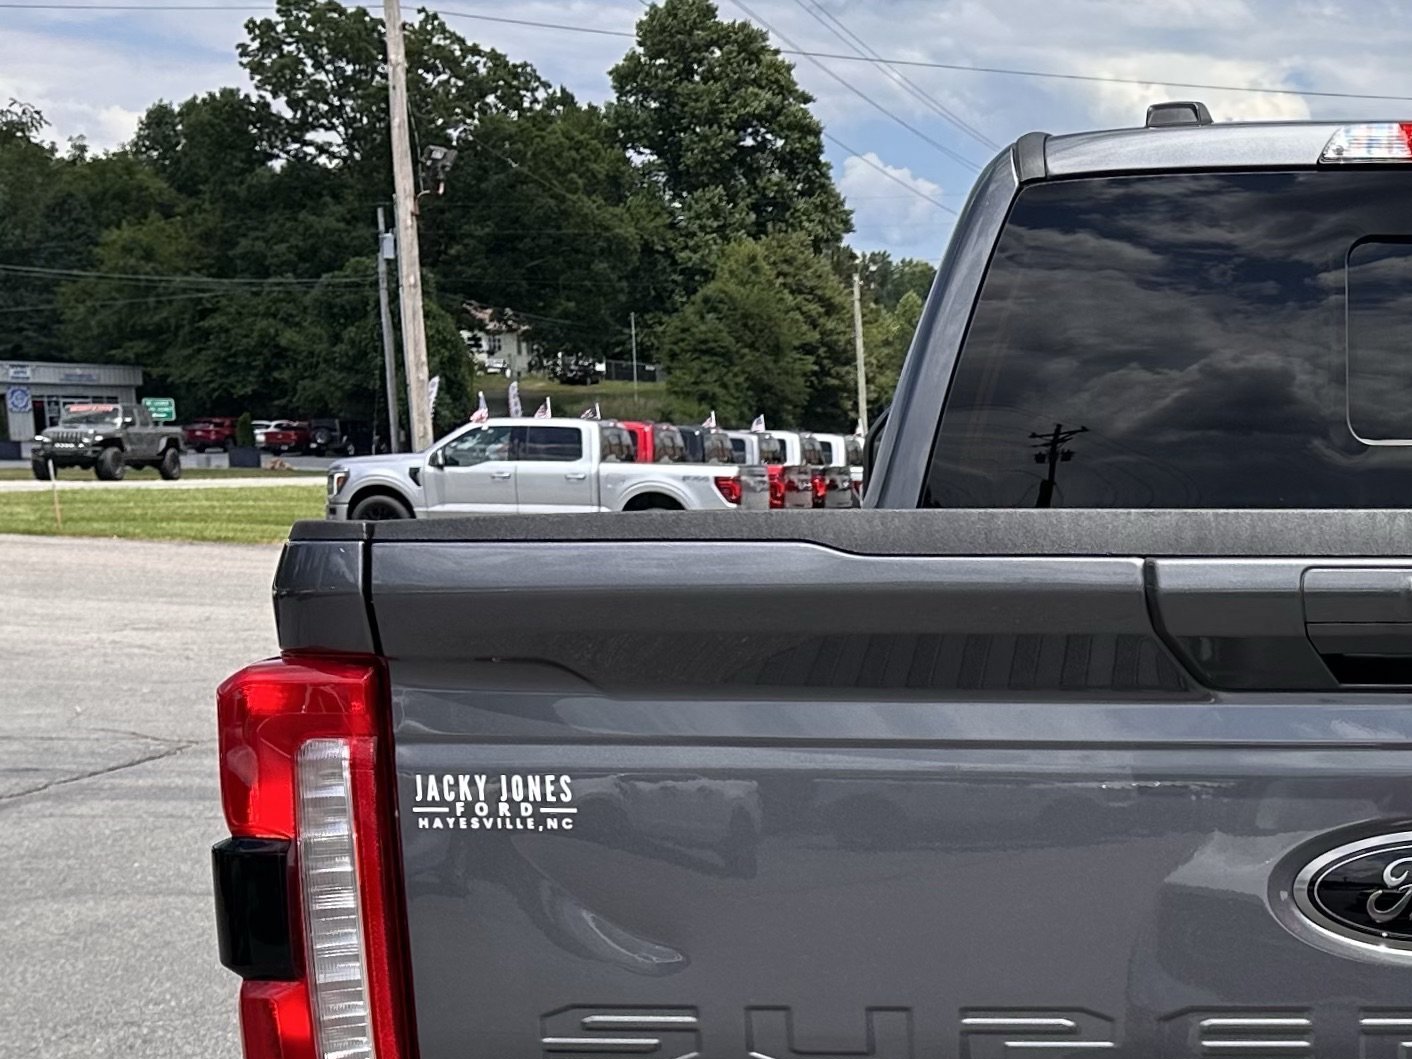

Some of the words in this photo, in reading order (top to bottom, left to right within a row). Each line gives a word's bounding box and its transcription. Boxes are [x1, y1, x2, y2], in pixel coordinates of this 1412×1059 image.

[415, 774, 487, 802] JACKY
[500, 774, 573, 802] JONES
[455, 802, 533, 817] FORD
